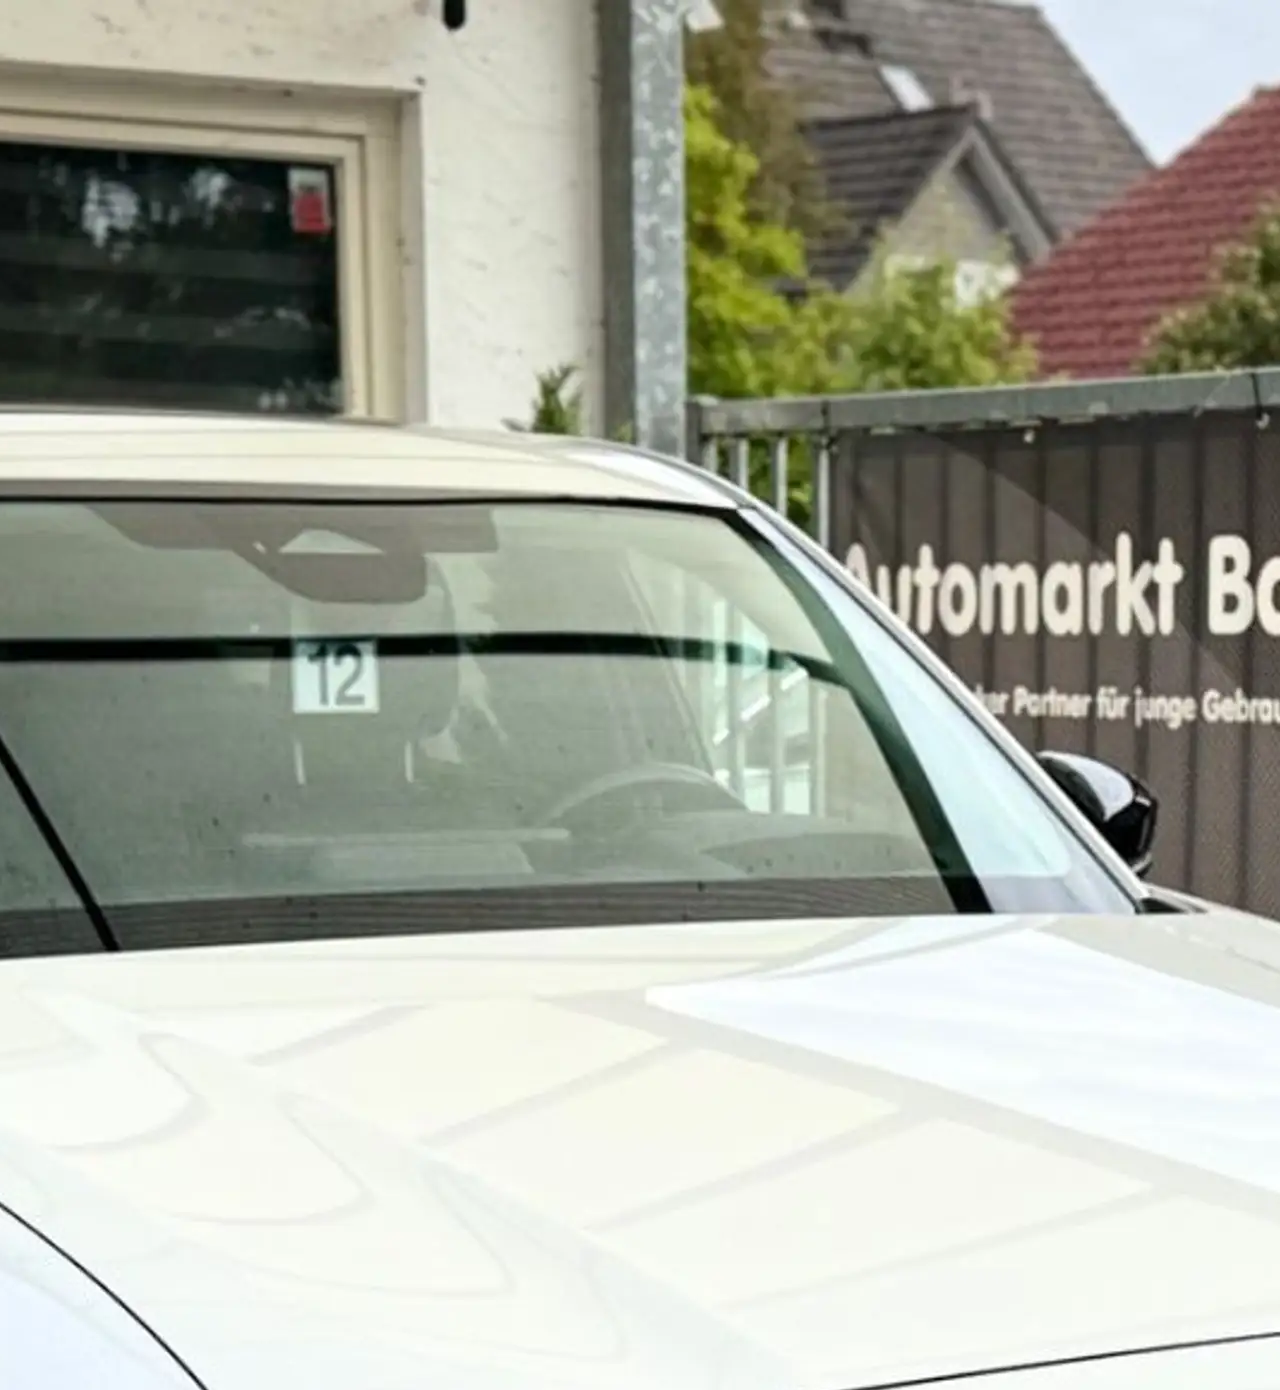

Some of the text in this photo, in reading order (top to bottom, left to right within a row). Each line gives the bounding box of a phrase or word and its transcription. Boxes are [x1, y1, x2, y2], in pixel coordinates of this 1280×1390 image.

[307, 643, 366, 706] 12
[1013, 685, 1093, 717] Partner
[1096, 685, 1129, 719] für
[1133, 685, 1198, 730] junge
